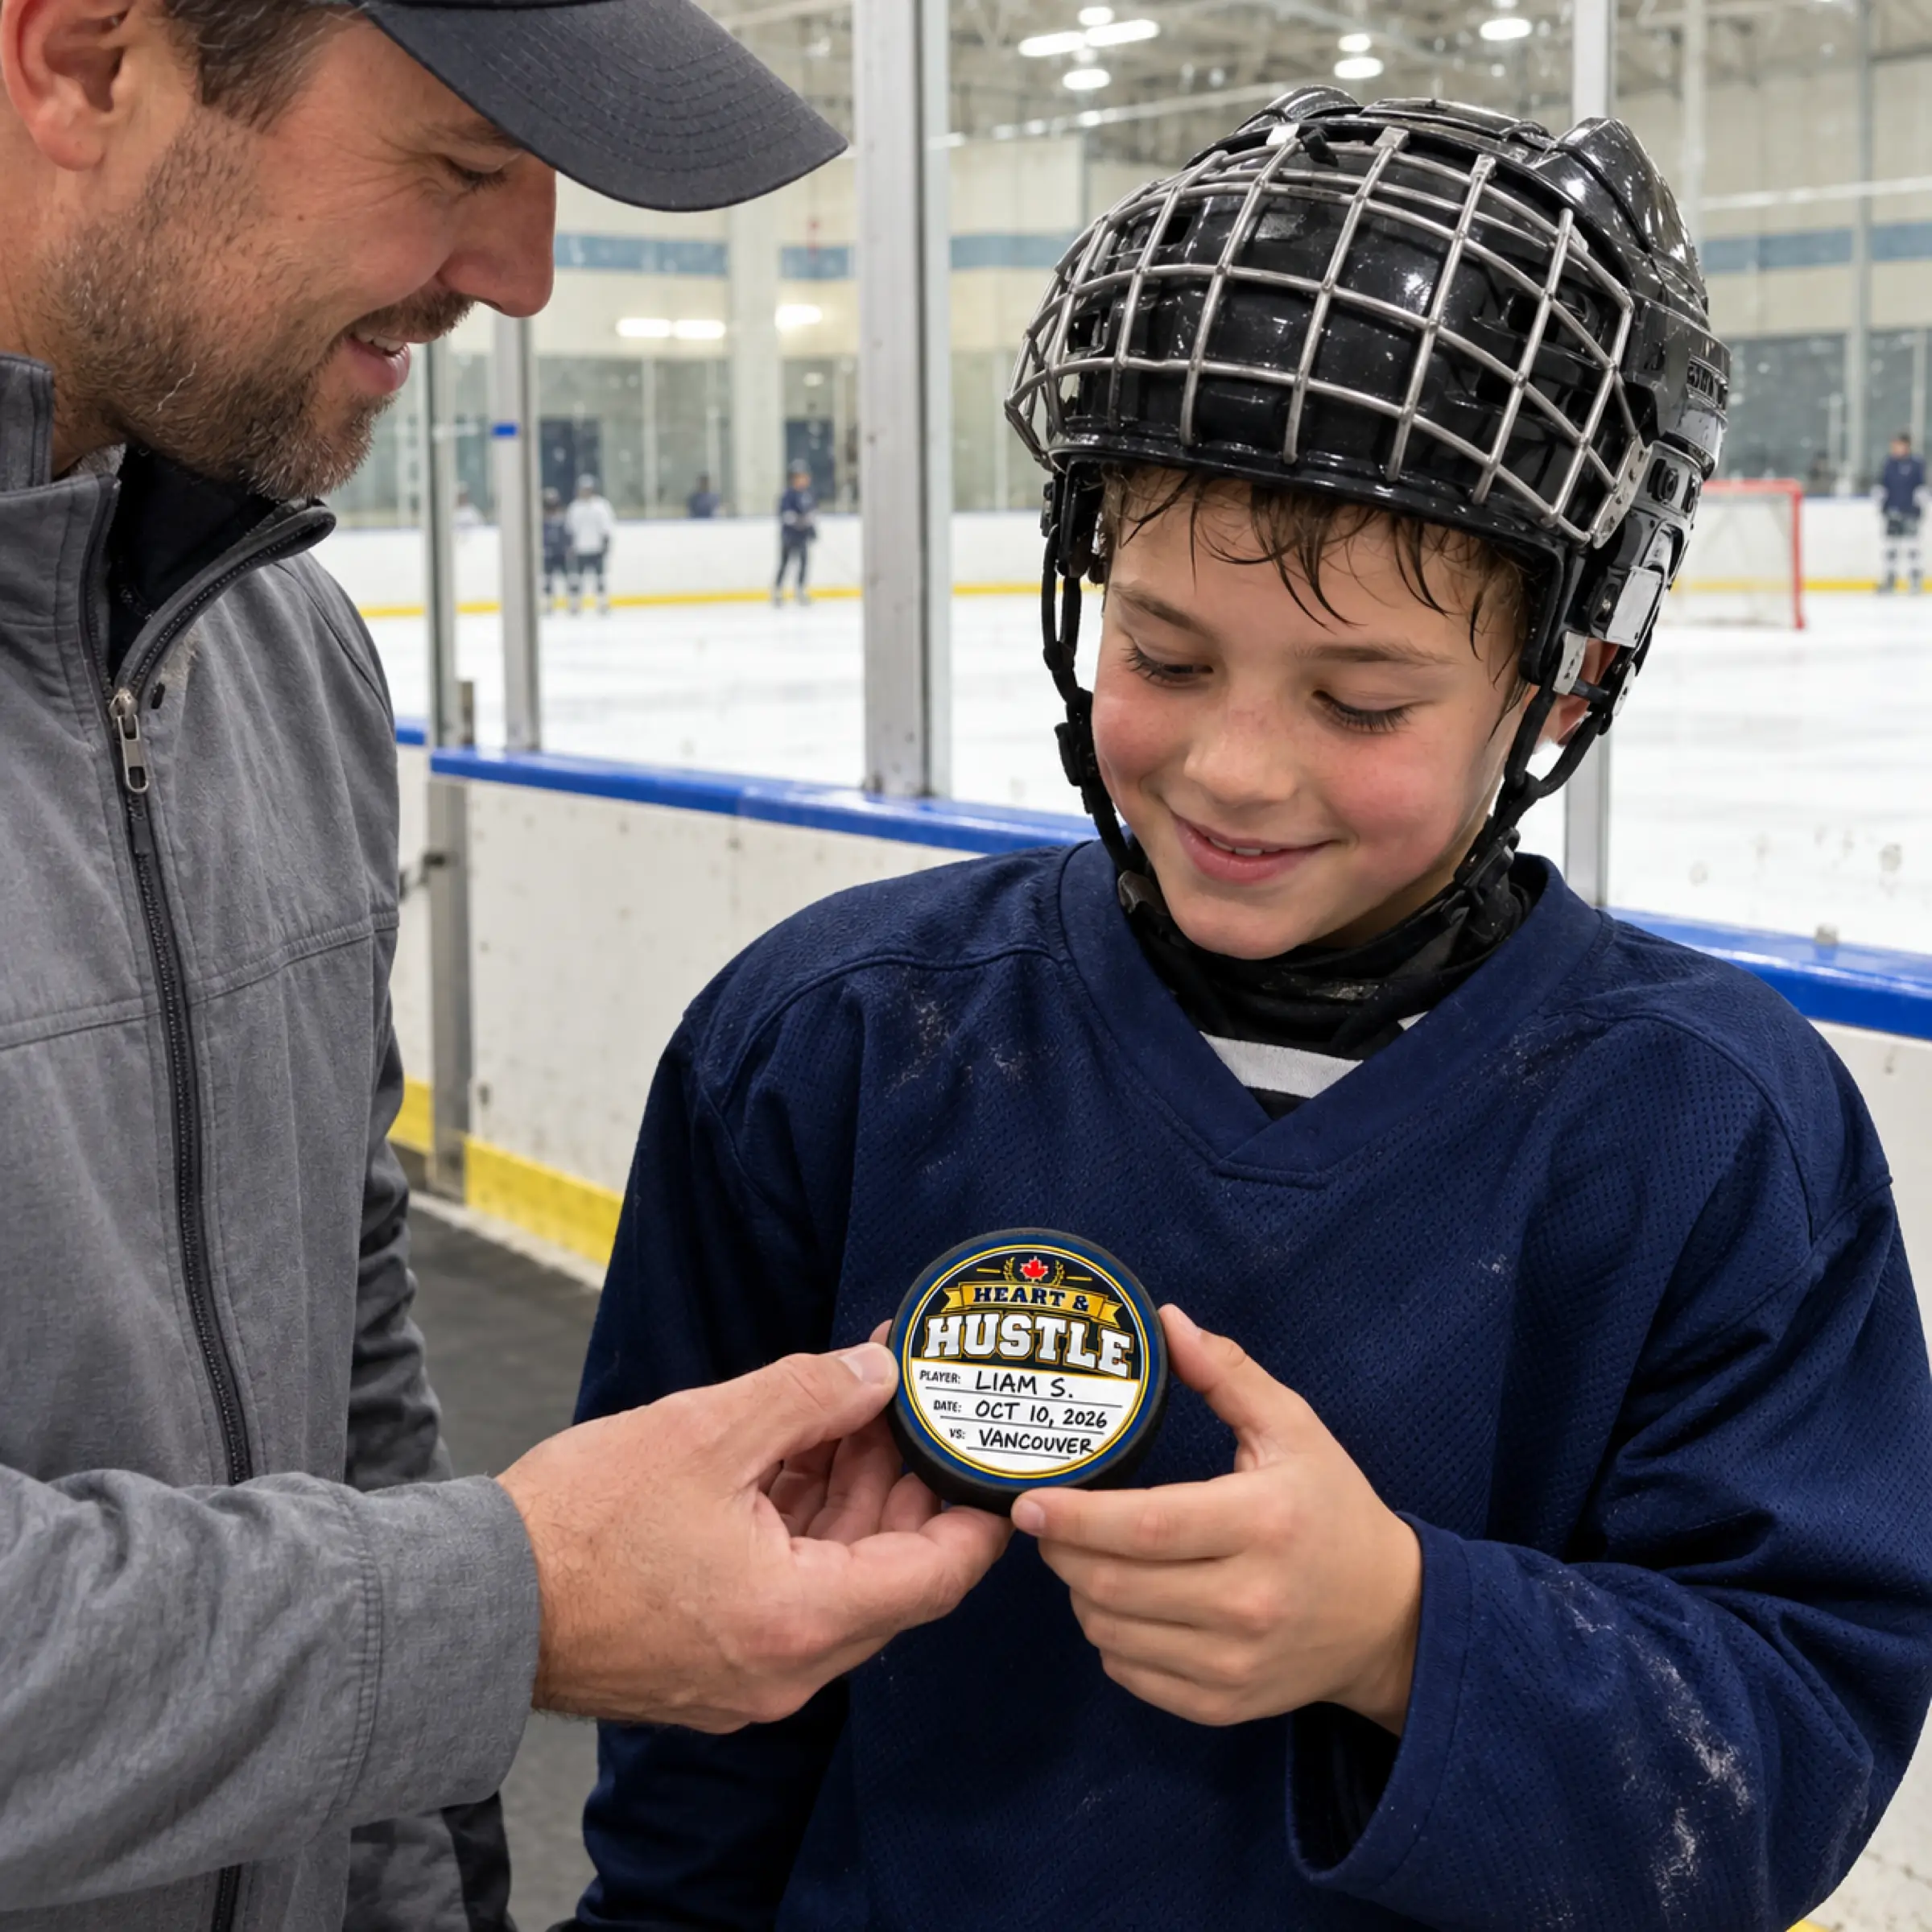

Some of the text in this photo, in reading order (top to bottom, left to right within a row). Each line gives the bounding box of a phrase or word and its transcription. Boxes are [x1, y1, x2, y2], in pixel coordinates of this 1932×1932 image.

[973, 1286, 1088, 1312] HEART &
[923, 1312, 1131, 1377] HUSTLE
[919, 1369, 1073, 1398] PLAYER: LIAM S.
[933, 1399, 1108, 1429] DATE: OCT 10, 2026
[948, 1426, 1094, 1455] VS: VANCOUVER
